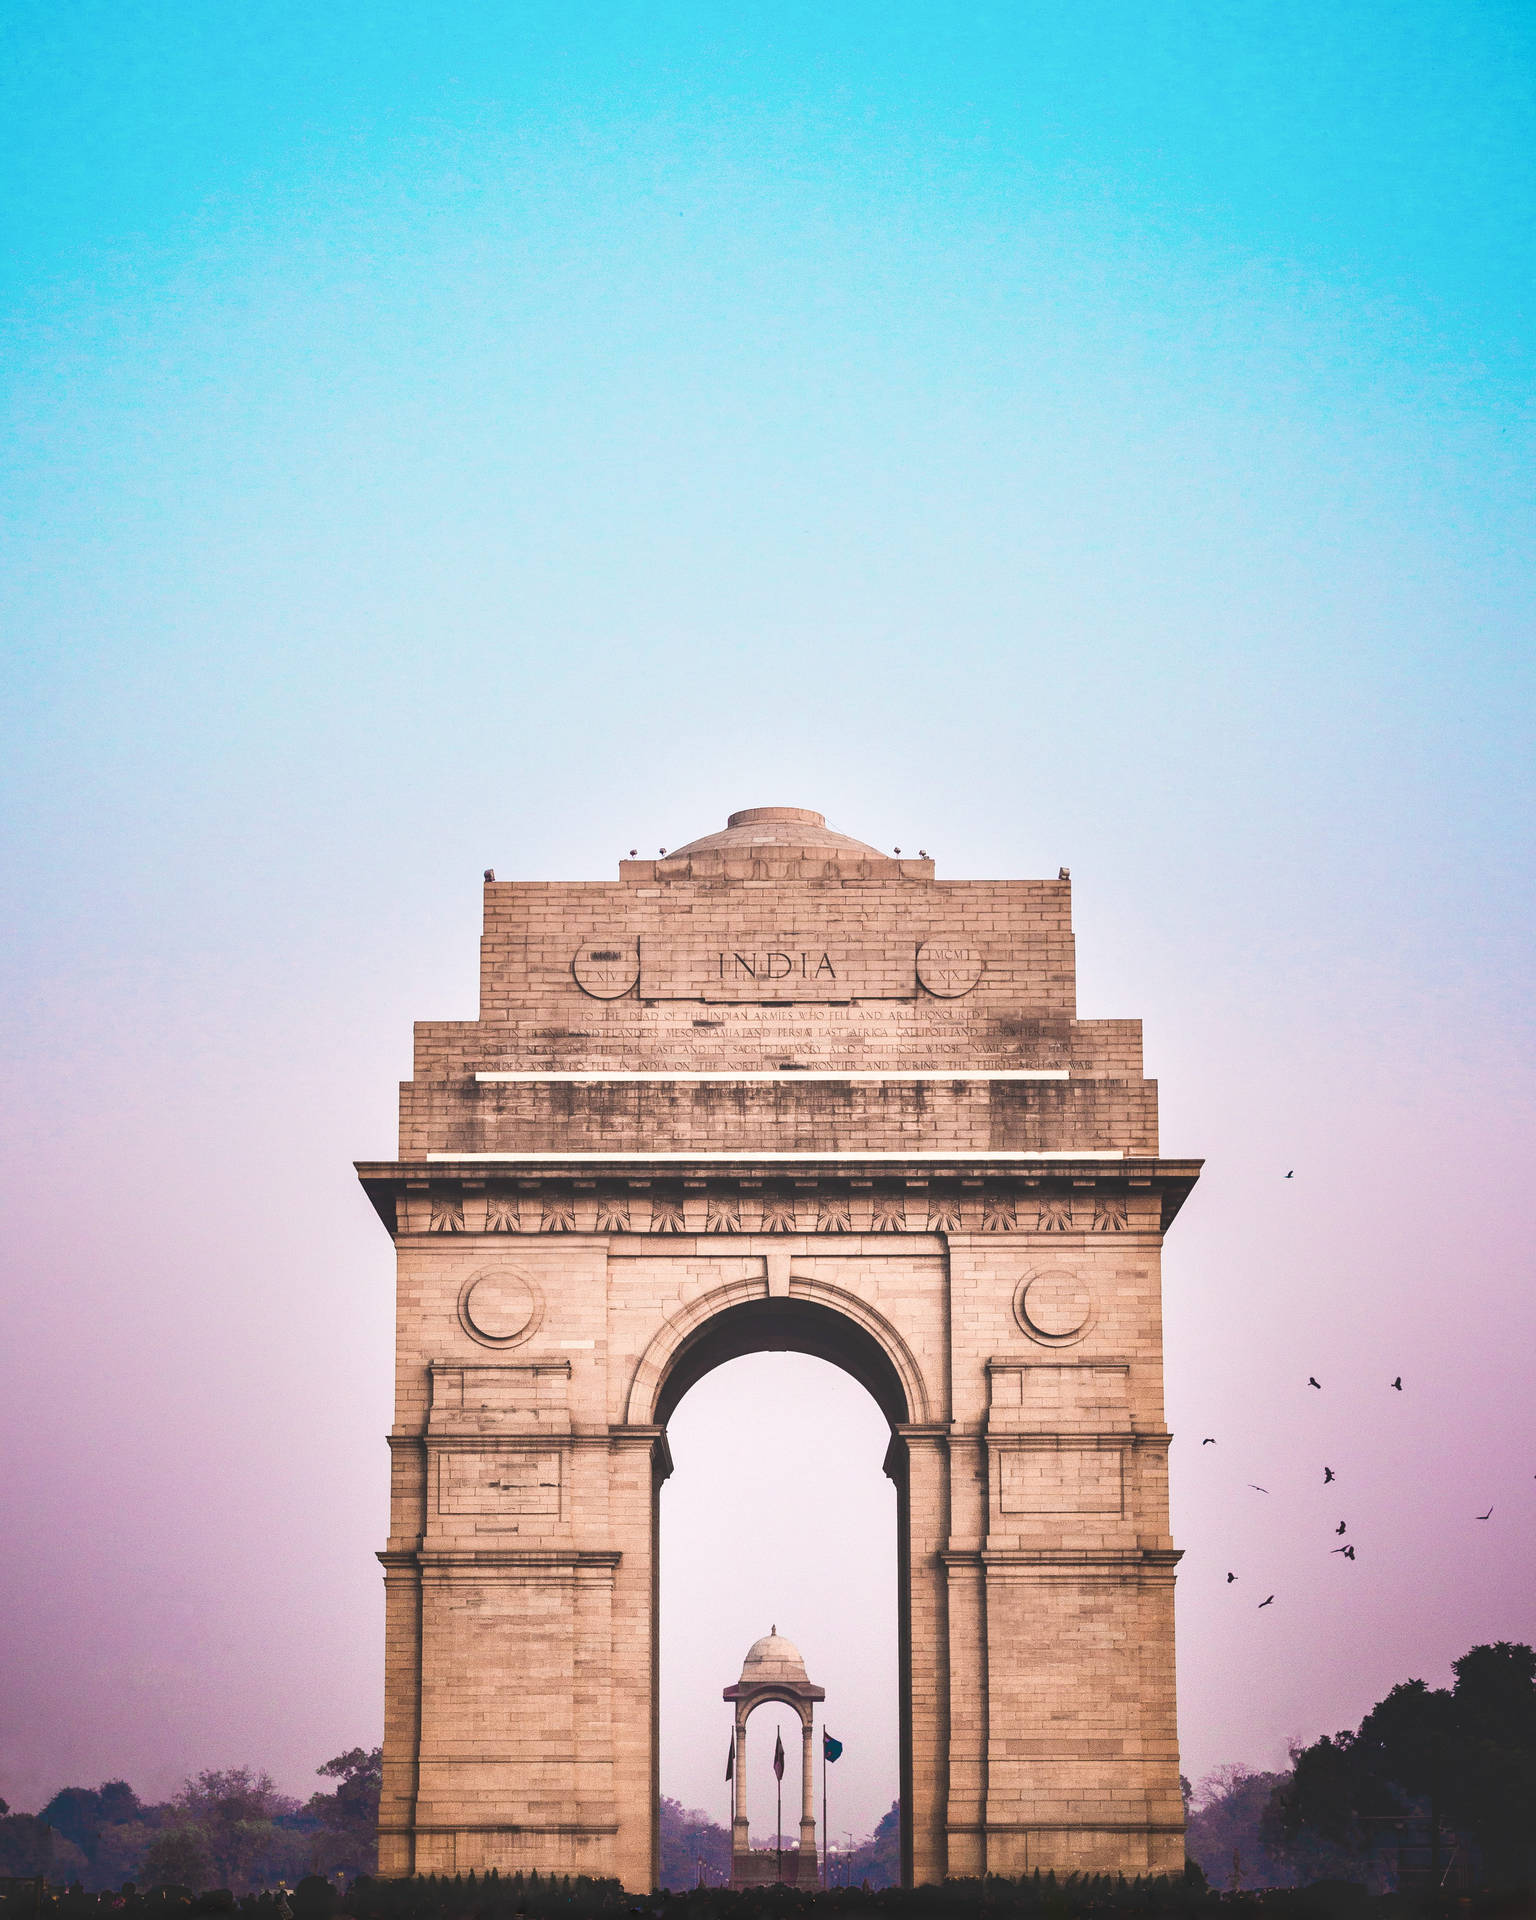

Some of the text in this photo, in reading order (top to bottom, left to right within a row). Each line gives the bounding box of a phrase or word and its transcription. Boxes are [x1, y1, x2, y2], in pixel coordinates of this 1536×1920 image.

[935, 950, 963, 960] MCM
[718, 952, 837, 979] INDIA
[595, 970, 617, 982] XIV
[937, 970, 960, 980] XIX
[581, 1011, 981, 1021] TO THE DEAD OF THE INDIAN ARMIES WHO FELL AND ARE HONOURED
[602, 1029, 658, 1038] FLANDERS
[666, 1029, 740, 1038] MESOPOTAMIA
[745, 1029, 771, 1038] AND
[819, 1028, 842, 1037] EAST
[851, 1028, 888, 1037] AFRICA
[896, 1028, 946, 1037] GALLIPOLI
[954, 1028, 978, 1037] AND
[595, 1046, 614, 1055] THE
[622, 1046, 641, 1055] FAR
[650, 1046, 675, 1055] EAST
[683, 1046, 706, 1055] AND
[714, 1046, 725, 1055] IN
[732, 1046, 773, 1055] SACRED
[779, 1046, 822, 1055] MEMORY
[830, 1045, 856, 1054] ALSO
[862, 1045, 874, 1054] OF
[881, 1045, 918, 1054] THOSE
[925, 1045, 960, 1054] WHOSE
[972, 1045, 1008, 1054] NAMES
[1016, 1045, 1037, 1054] ARE
[1049, 1045, 1073, 1054] HER
[531, 1062, 554, 1071] AND
[559, 1062, 585, 1071] WHO
[591, 1062, 610, 1071] FELL
[619, 1062, 630, 1071] IN
[638, 1062, 668, 1071] INDIA
[698, 1062, 718, 1071] THE
[728, 1062, 762, 1071] NORTH
[866, 1061, 890, 1070] AND
[896, 1061, 939, 1070] DURING
[948, 1061, 967, 1070] THE
[977, 1061, 1011, 1070] THIRD
[1069, 1061, 1093, 1070] WAR
